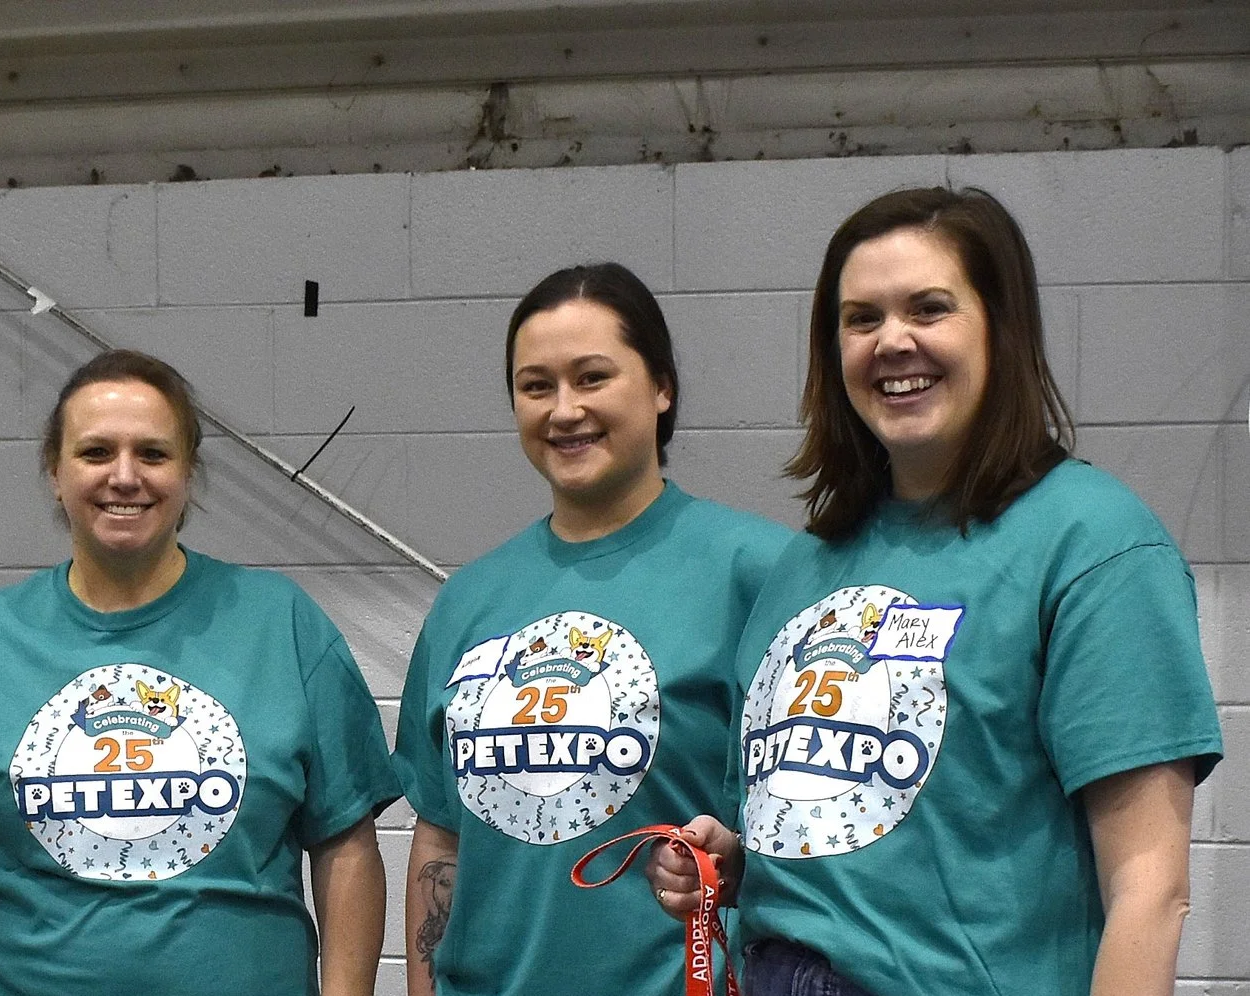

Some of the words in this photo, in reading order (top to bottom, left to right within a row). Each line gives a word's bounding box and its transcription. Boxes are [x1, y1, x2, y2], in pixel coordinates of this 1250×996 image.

[803, 642, 865, 664] Celebrating
[521, 662, 582, 680] Celebrating
[511, 684, 581, 725] 25th
[787, 669, 859, 717] 25th
[93, 714, 160, 733] Celebrating
[93, 736, 165, 774] 25th
